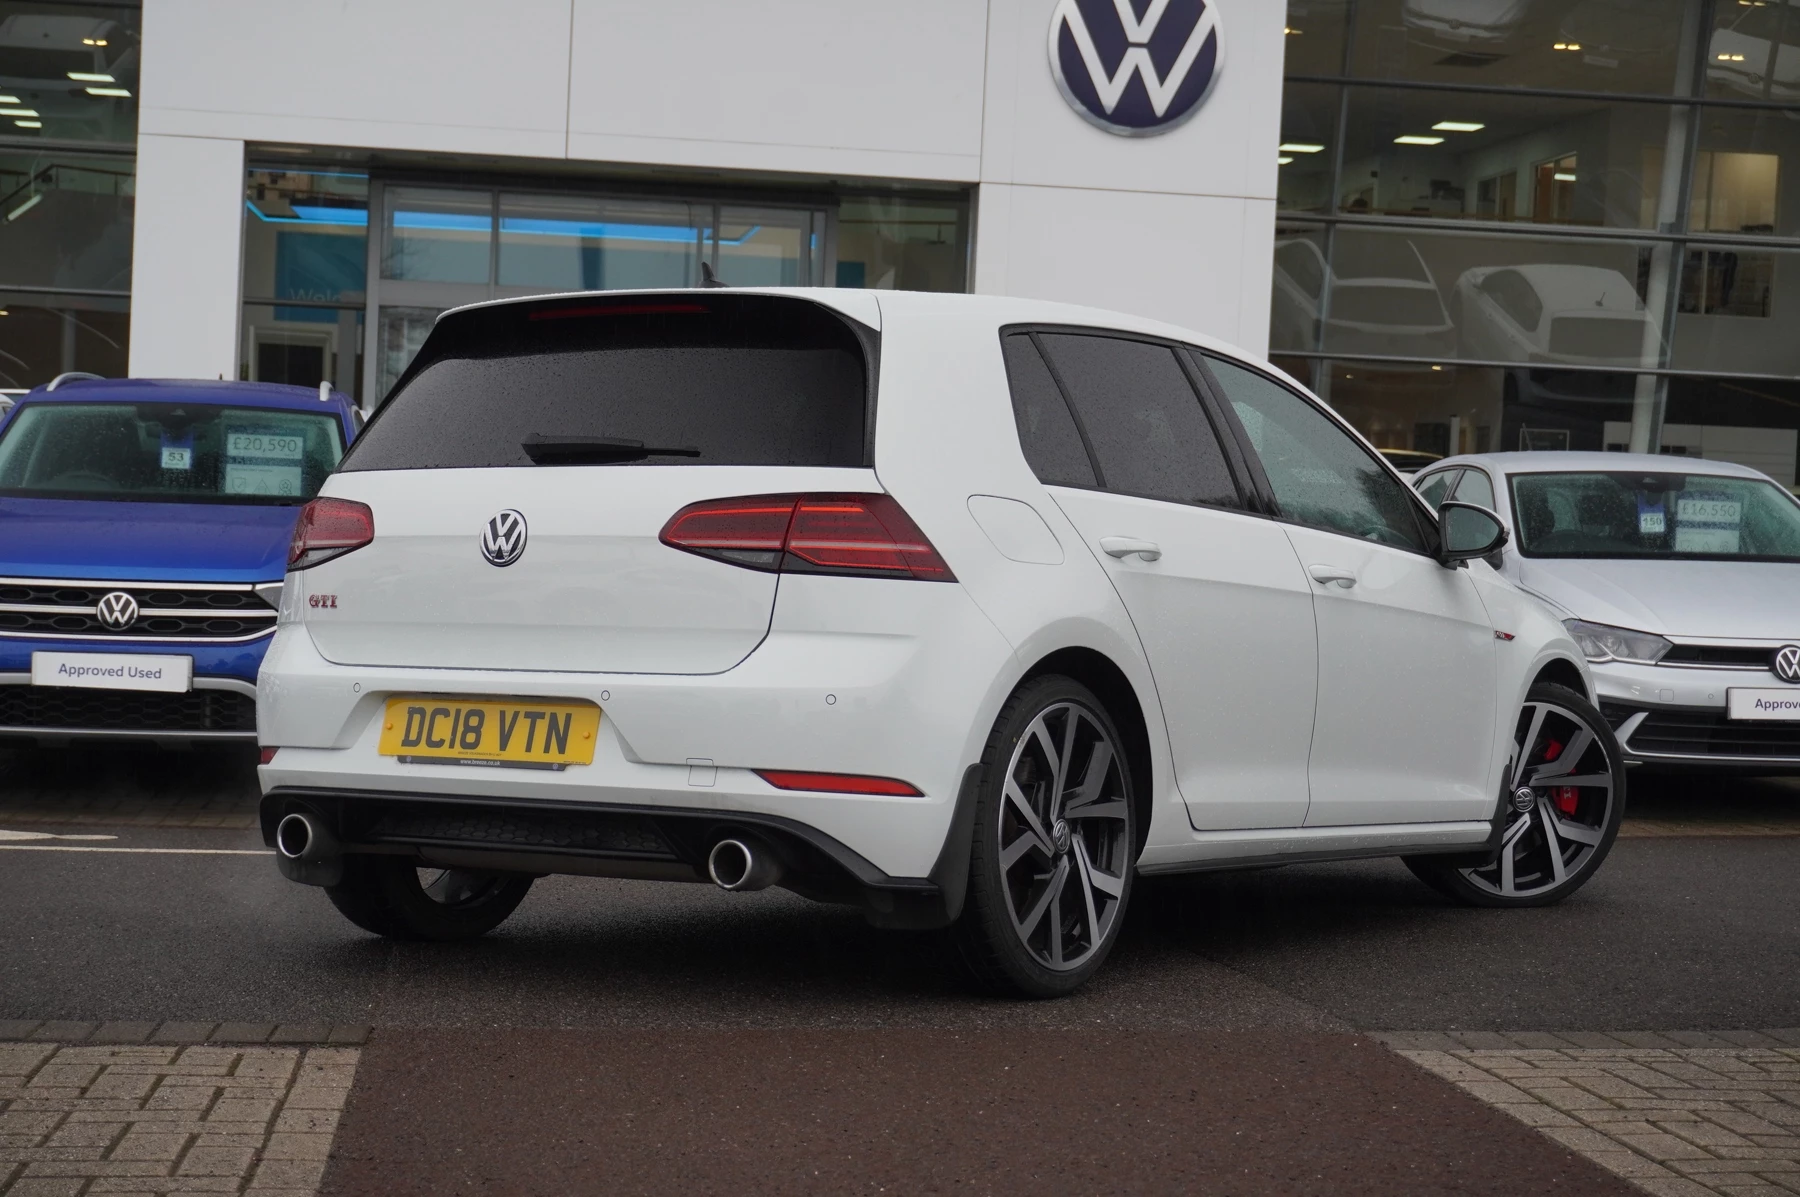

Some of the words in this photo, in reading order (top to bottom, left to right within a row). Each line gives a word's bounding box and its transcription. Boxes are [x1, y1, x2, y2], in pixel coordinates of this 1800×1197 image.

[233, 437, 297, 453] £20,590
[168, 452, 184, 462] 53
[1642, 516, 1662, 526] 150
[308, 594, 338, 609] GTI
[58, 663, 125, 678] Approved
[128, 666, 162, 679] Used
[400, 706, 485, 750] DC18
[499, 709, 573, 755] VTN
